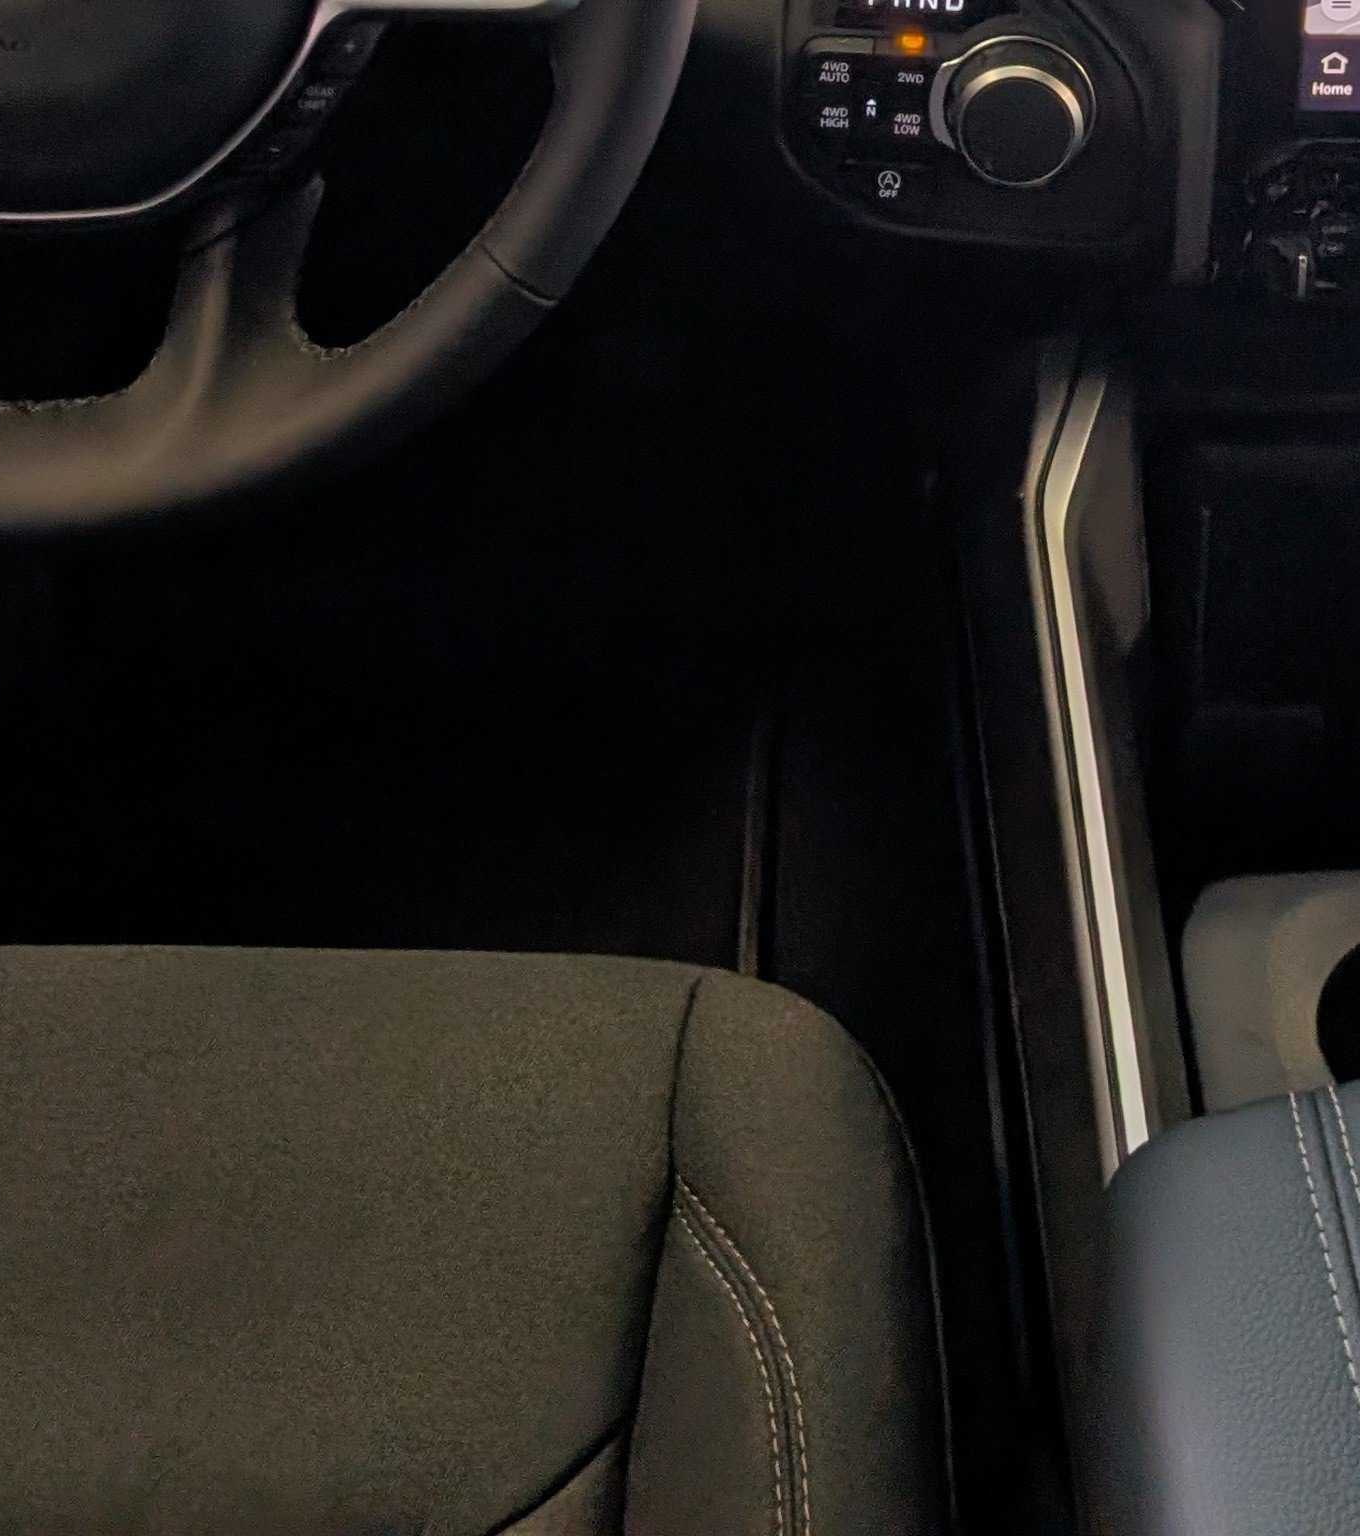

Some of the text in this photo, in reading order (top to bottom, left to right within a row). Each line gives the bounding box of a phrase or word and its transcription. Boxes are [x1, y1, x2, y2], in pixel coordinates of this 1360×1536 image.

[821, 61, 850, 72] 4WD
[819, 71, 850, 83] AUTO
[897, 72, 925, 84] 2WD
[1311, 81, 1354, 97] Home
[821, 106, 849, 118] 4WD
[865, 106, 877, 117] N
[819, 117, 849, 129] HIGH
[893, 112, 921, 125] 4WD
[893, 124, 920, 136] LOW
[878, 188, 899, 198] OFF
